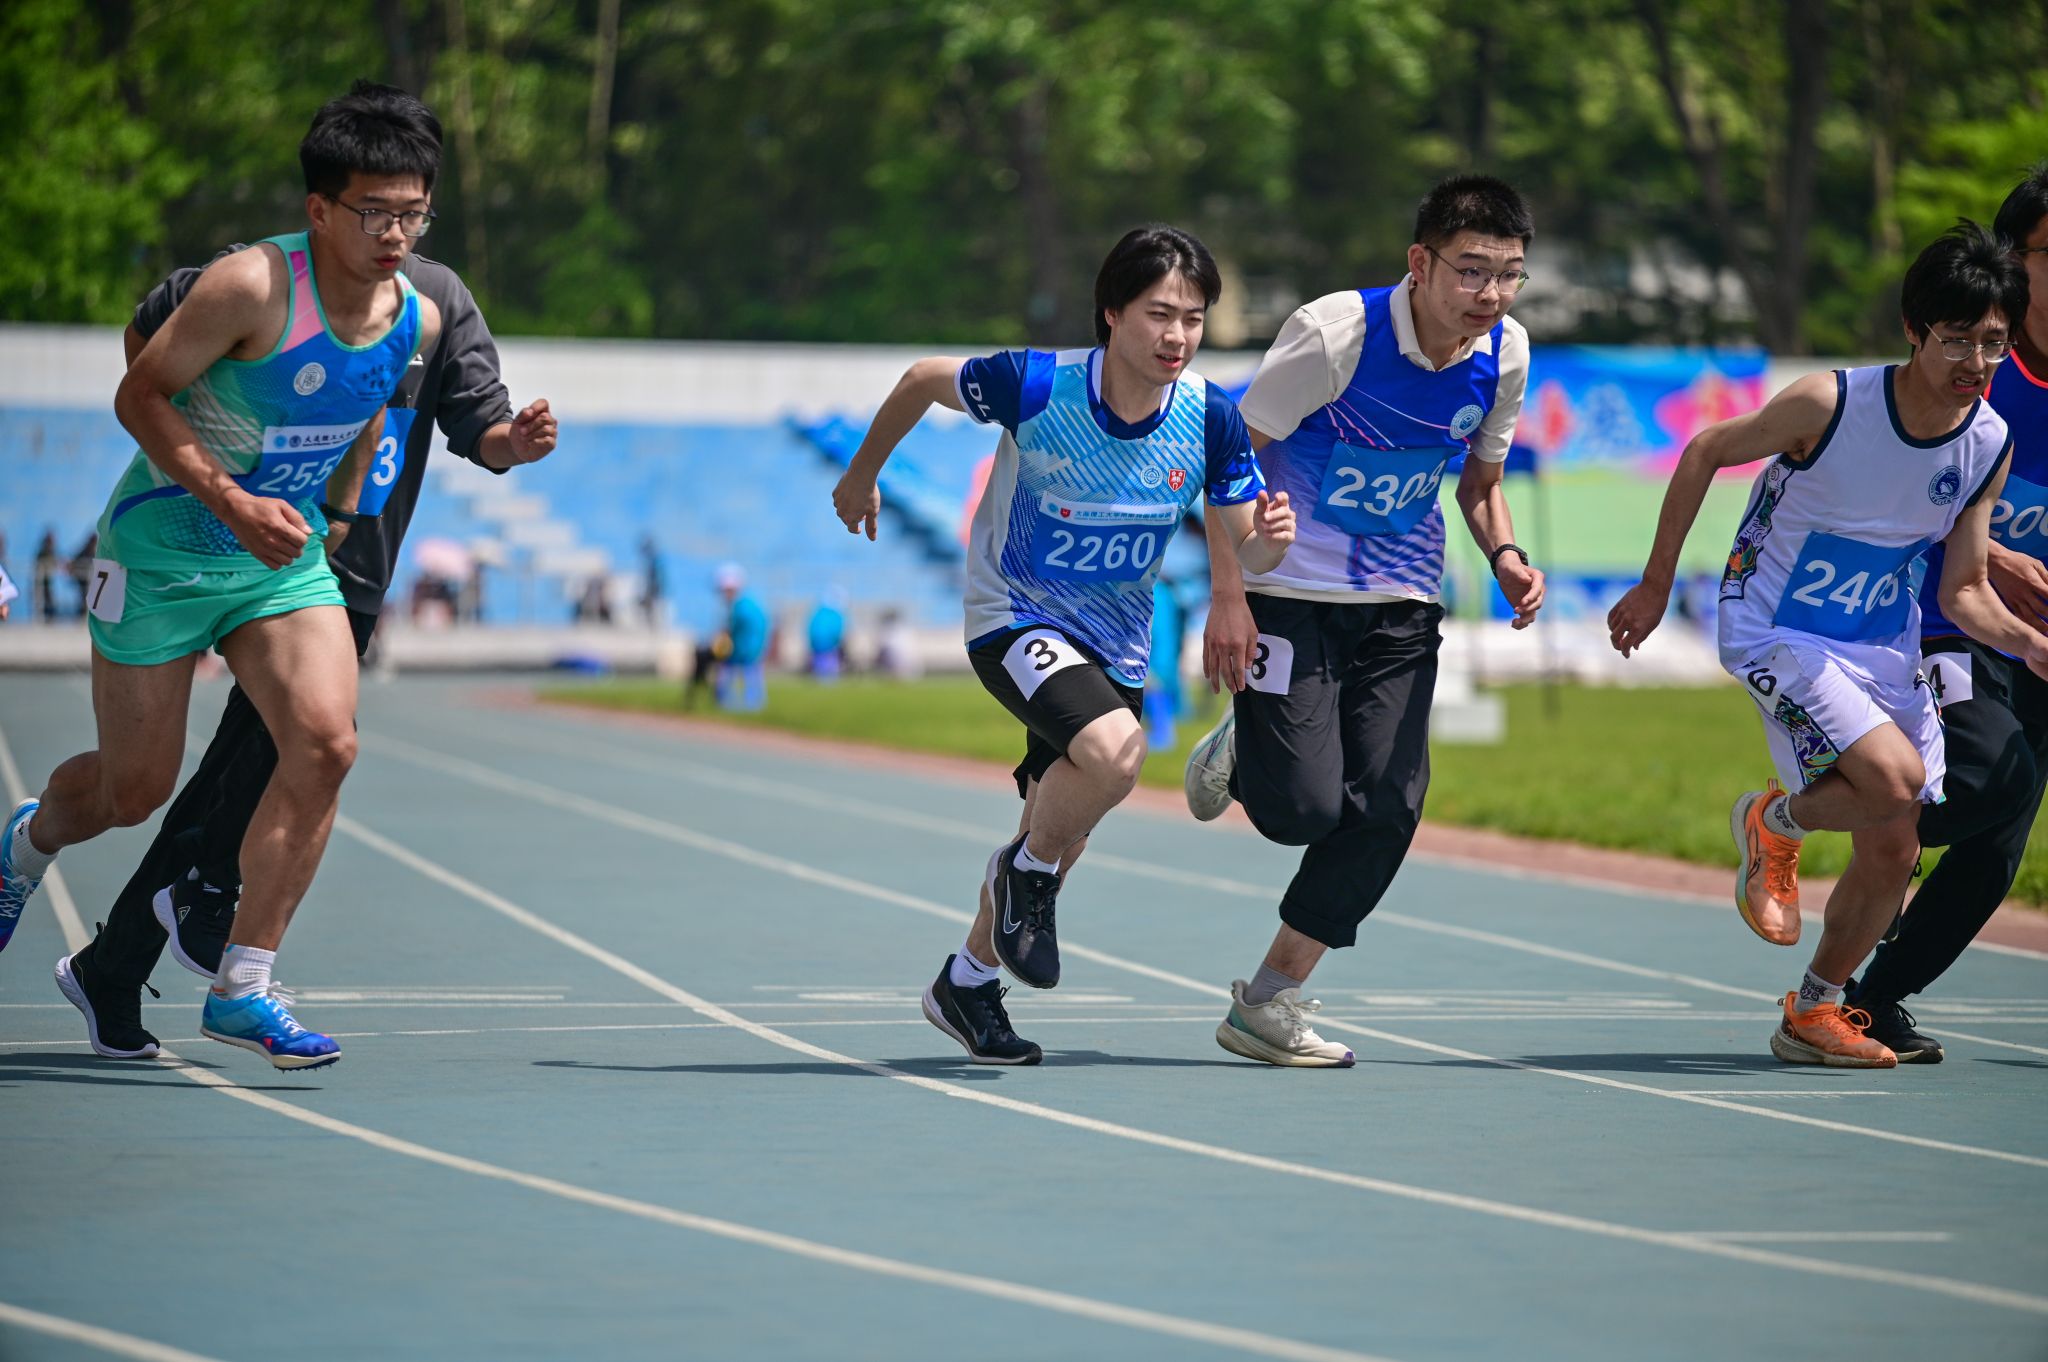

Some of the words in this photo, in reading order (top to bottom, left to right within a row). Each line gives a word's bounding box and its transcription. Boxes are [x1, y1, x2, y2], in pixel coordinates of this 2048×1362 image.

[258, 446, 349, 493] 255
[1045, 529, 1156, 572] 2260
[92, 571, 109, 610] 7
[1024, 638, 1059, 671] 3
[1251, 642, 1270, 680] 8
[1747, 667, 1778, 697] 6
[1929, 663, 1946, 699] 4
